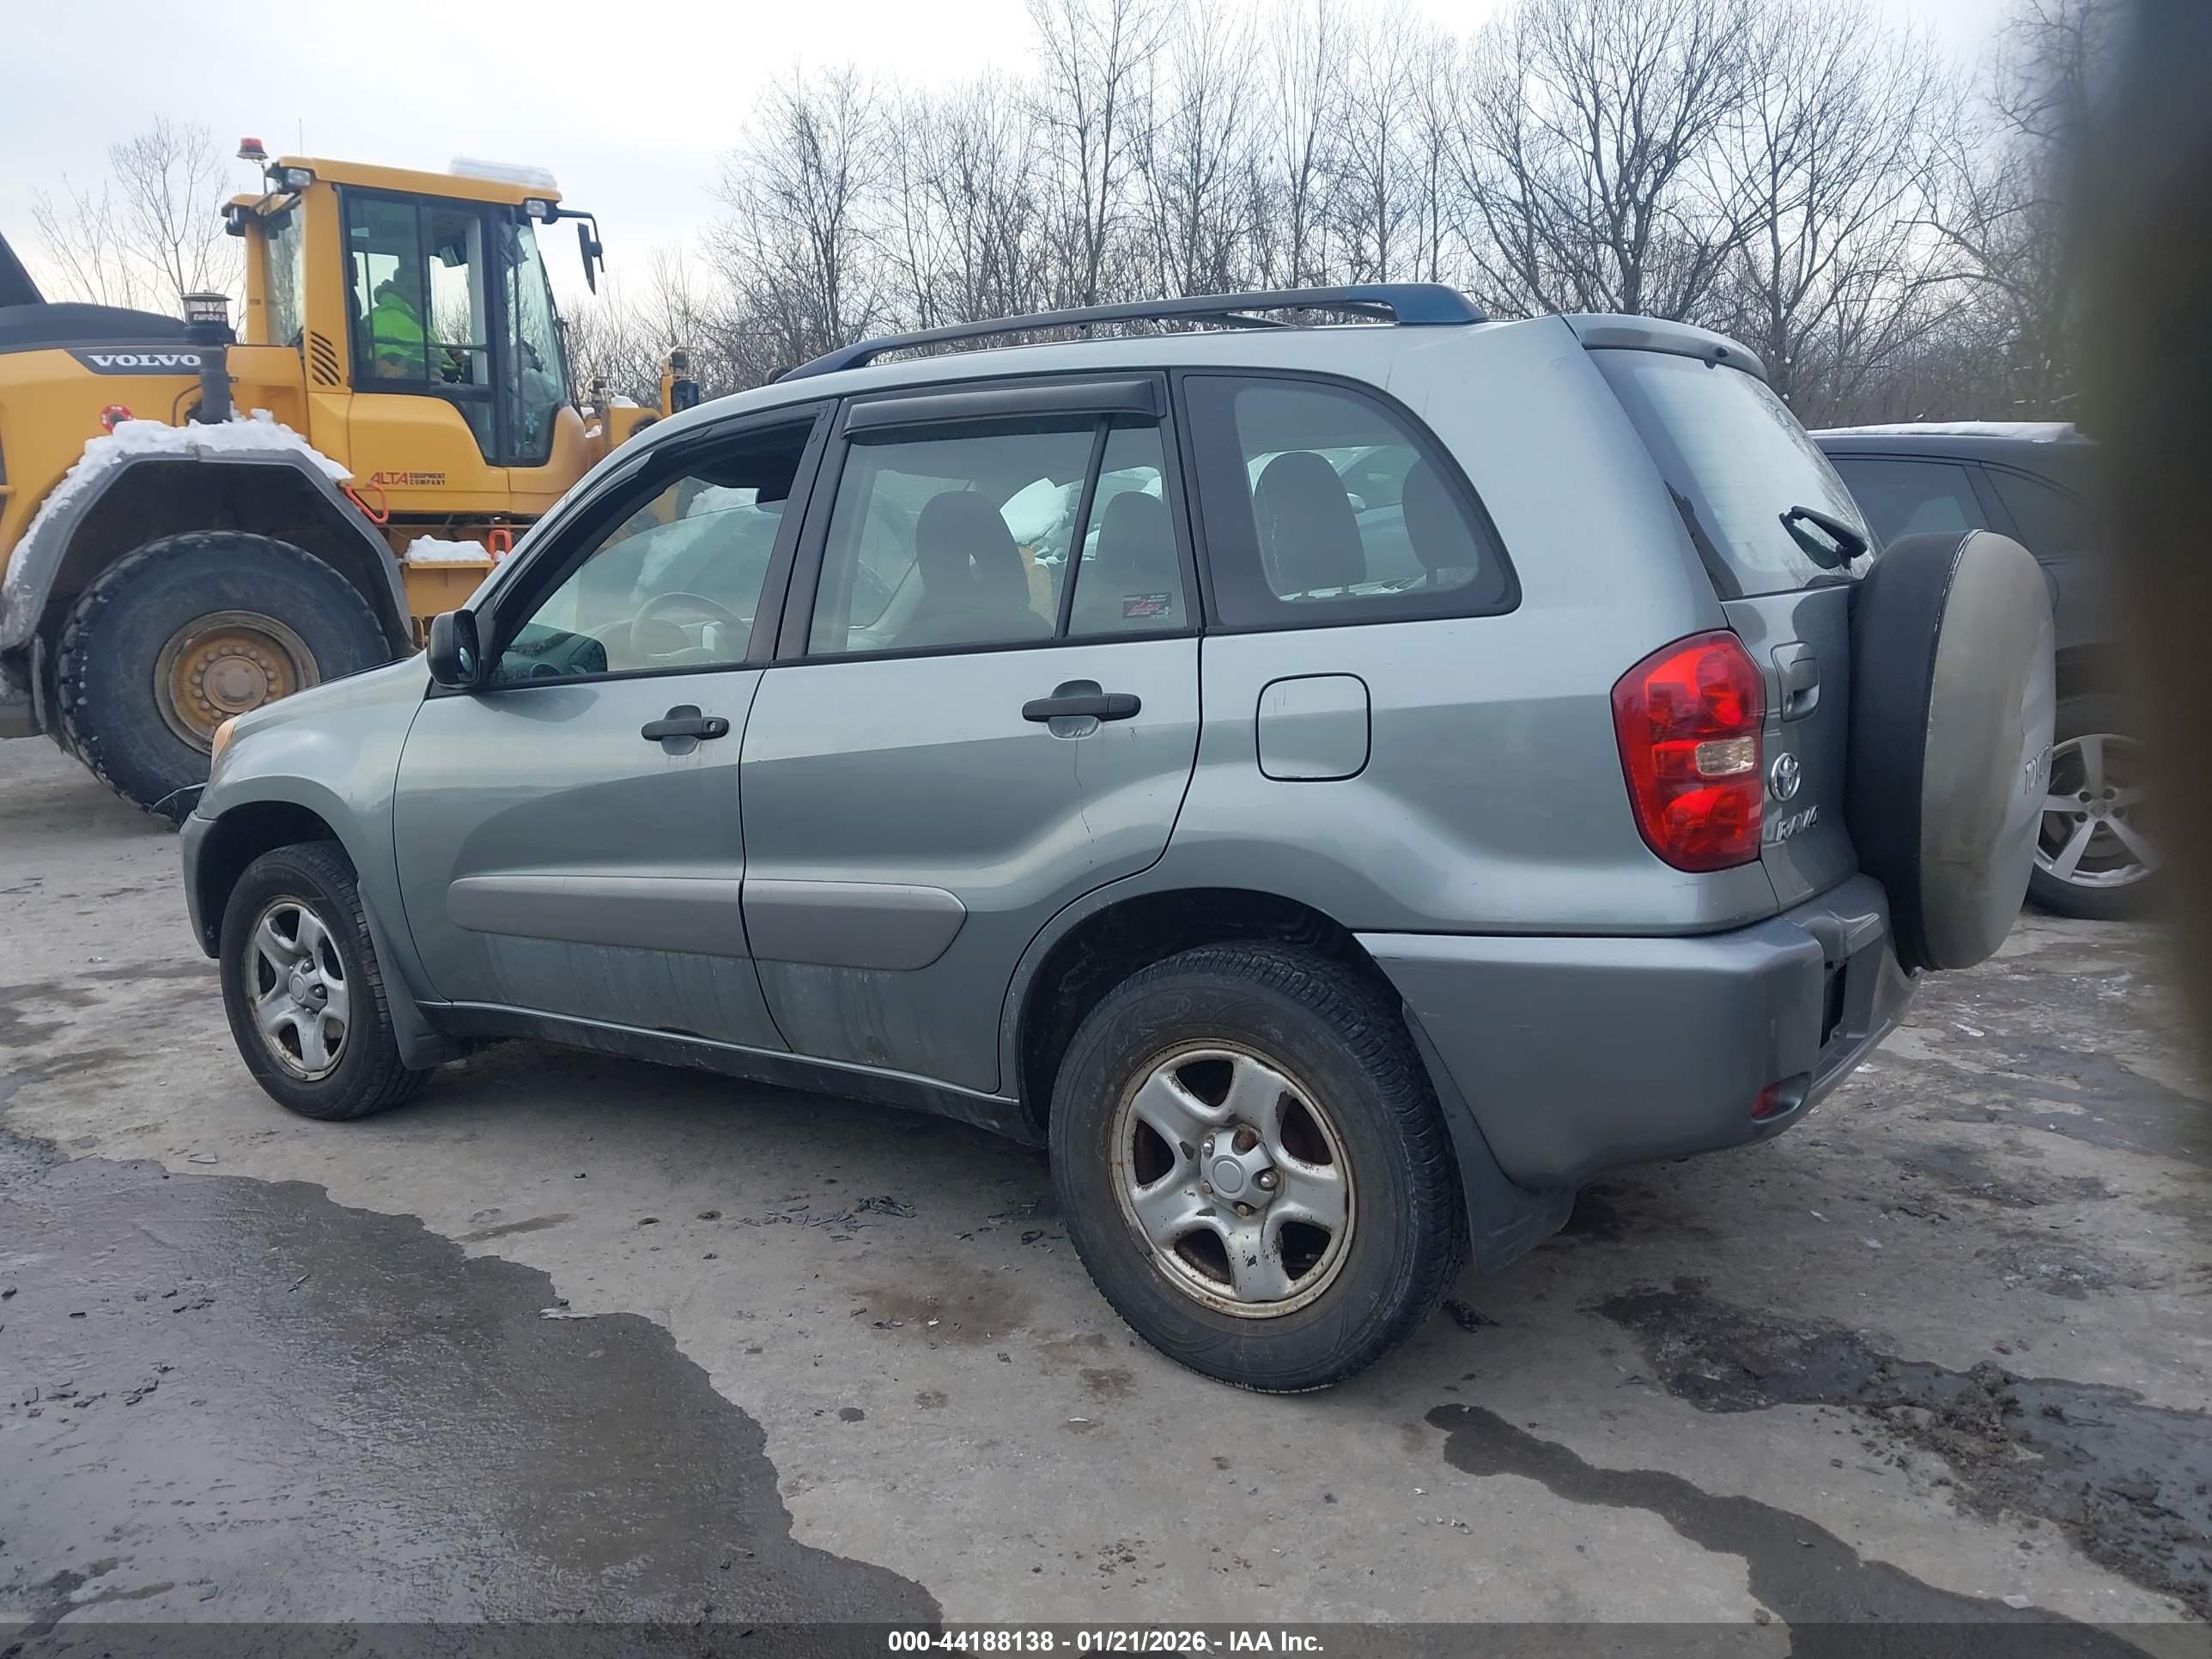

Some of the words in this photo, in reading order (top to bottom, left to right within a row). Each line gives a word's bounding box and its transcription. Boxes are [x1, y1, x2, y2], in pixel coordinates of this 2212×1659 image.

[88, 354, 201, 366] VOLVO
[370, 471, 408, 485] ALTA
[1775, 805, 1819, 841] RAV4
